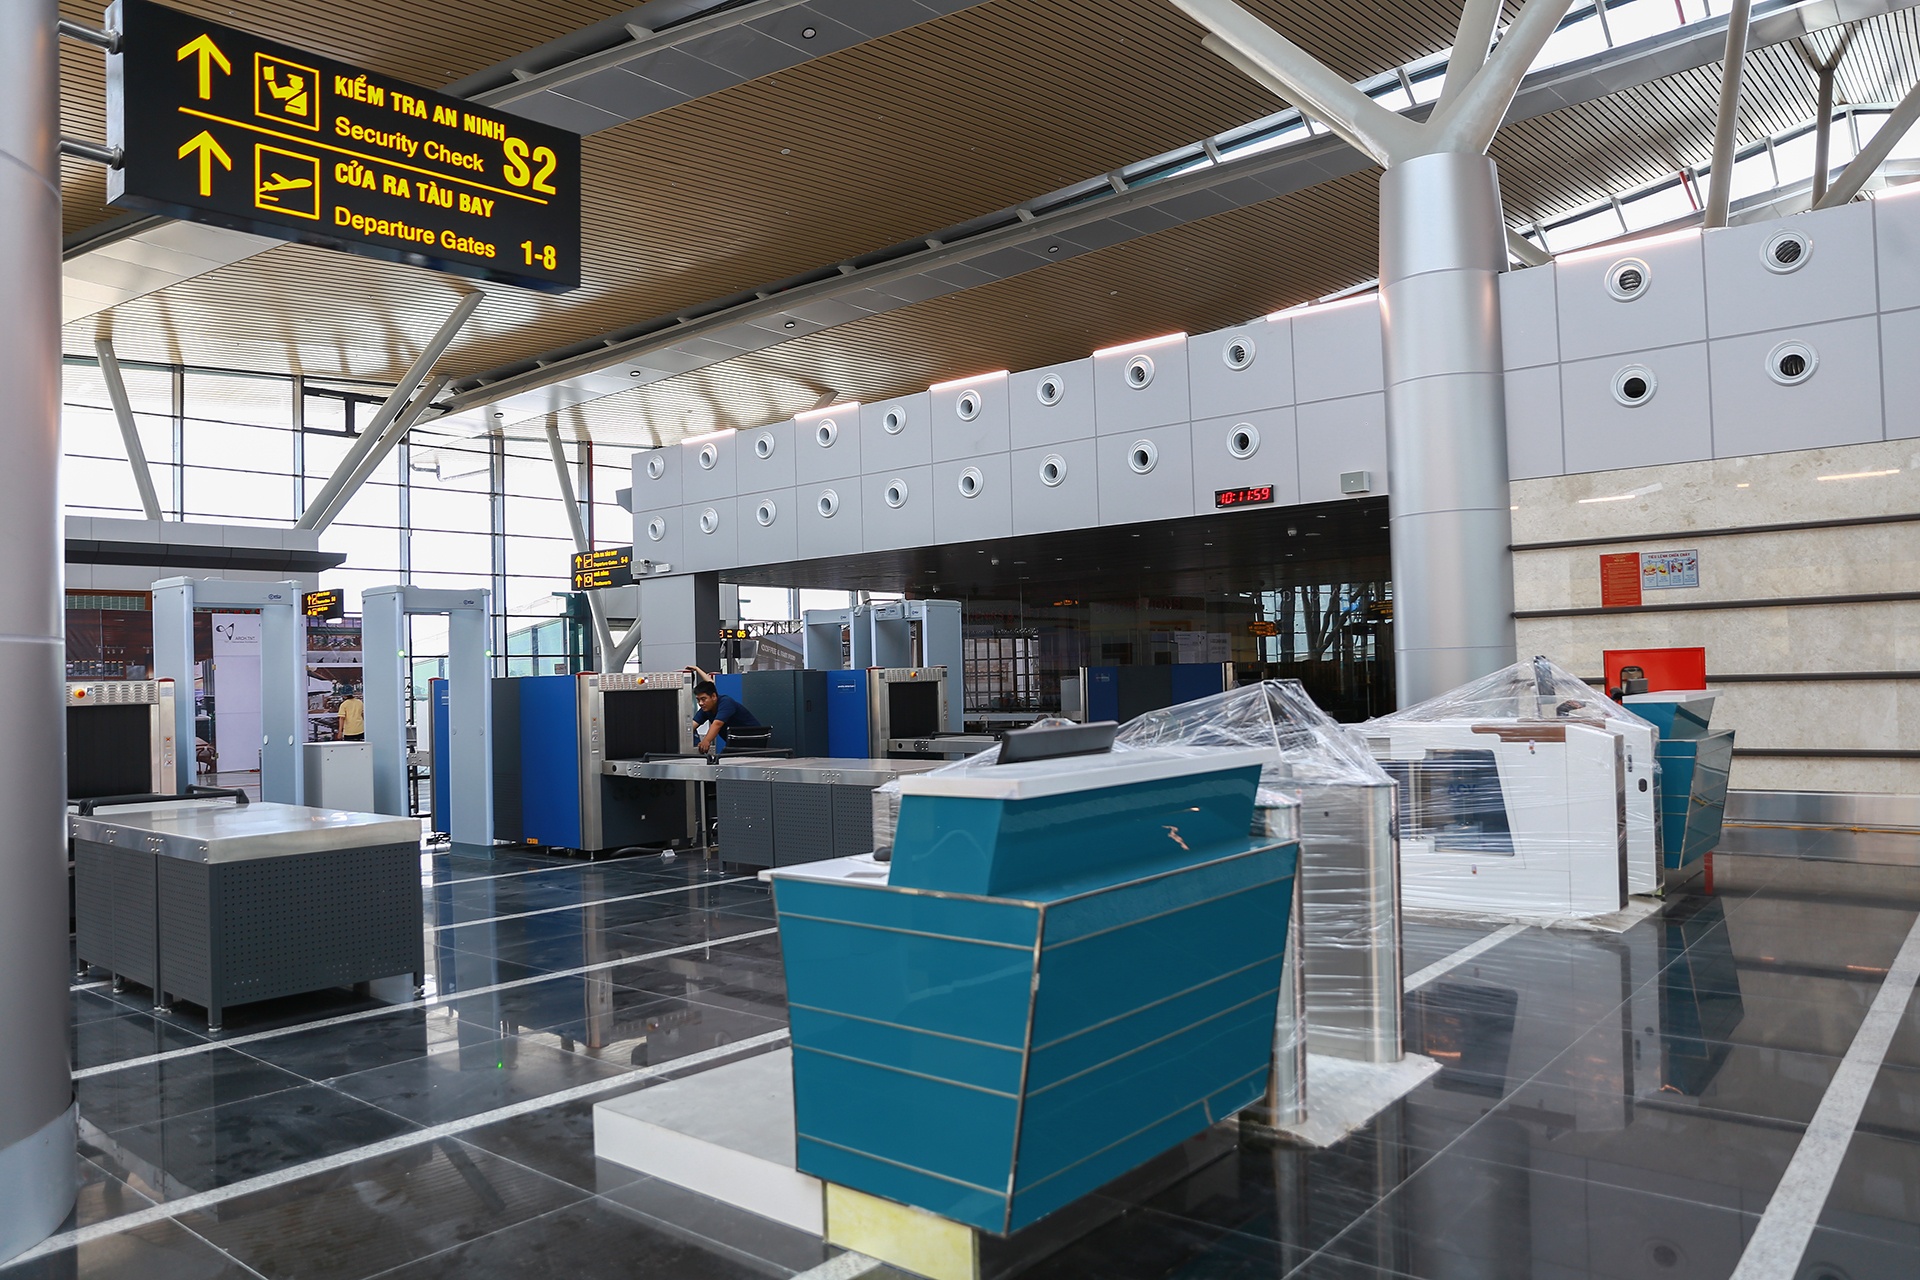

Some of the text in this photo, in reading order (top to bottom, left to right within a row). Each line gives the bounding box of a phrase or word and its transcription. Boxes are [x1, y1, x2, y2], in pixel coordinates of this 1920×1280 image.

[334, 74, 505, 142] KIỂM TRA AN NINH
[334, 116, 485, 173] Security Check
[503, 136, 557, 196] S2
[334, 160, 495, 219] CỬA RA TÀU BAY
[334, 205, 497, 259] Departure Gates
[521, 240, 557, 271] 1-8
[1220, 487, 1271, 504] 10:11:59
[736, 630, 746, 638] 05
